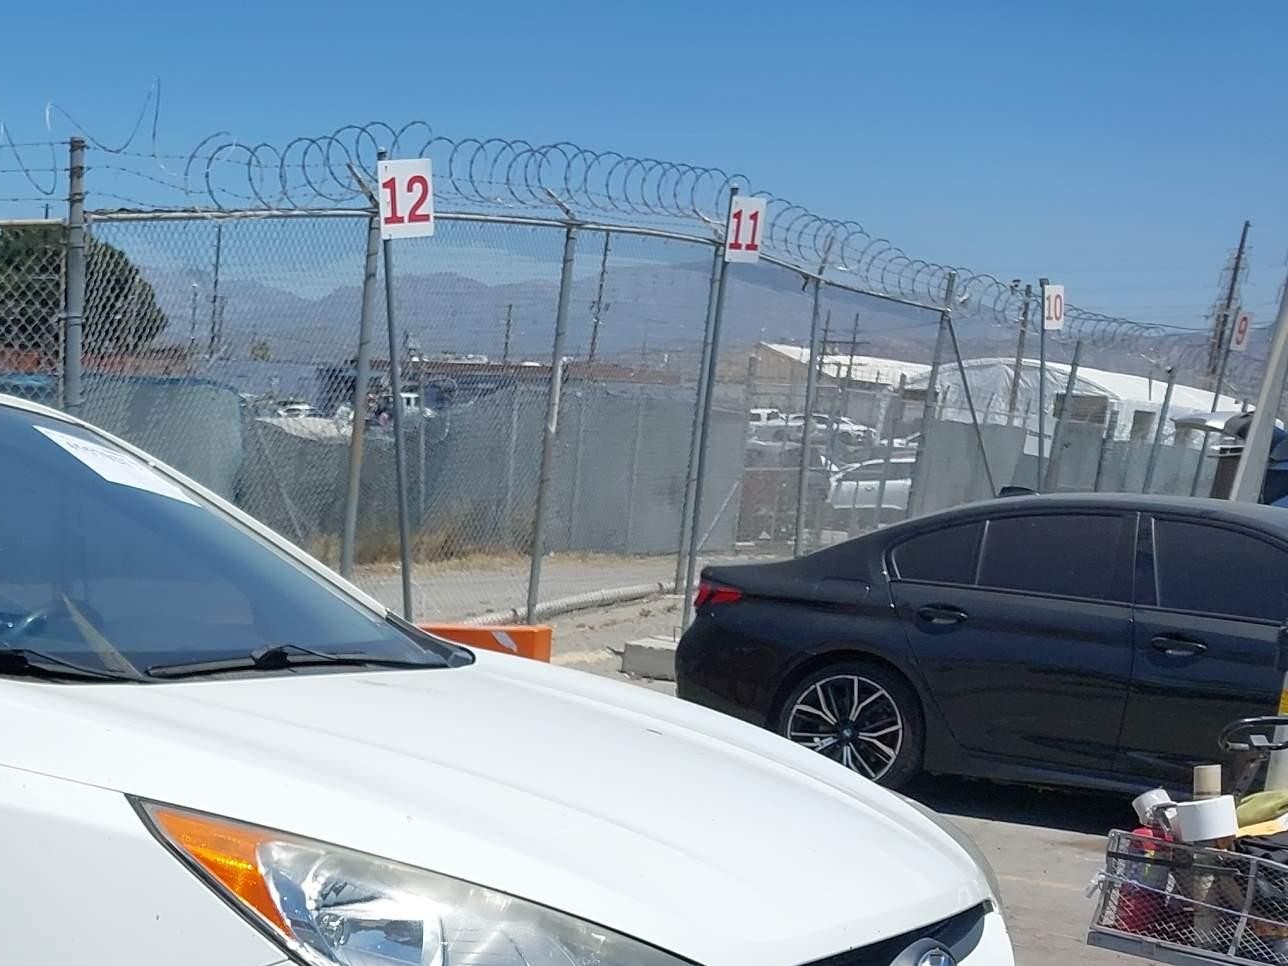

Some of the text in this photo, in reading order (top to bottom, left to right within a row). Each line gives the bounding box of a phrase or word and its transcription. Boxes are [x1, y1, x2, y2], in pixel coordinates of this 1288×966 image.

[382, 175, 431, 225] 12
[729, 209, 759, 251] 11
[1046, 294, 1063, 321] 10
[1235, 316, 1249, 345] 9
